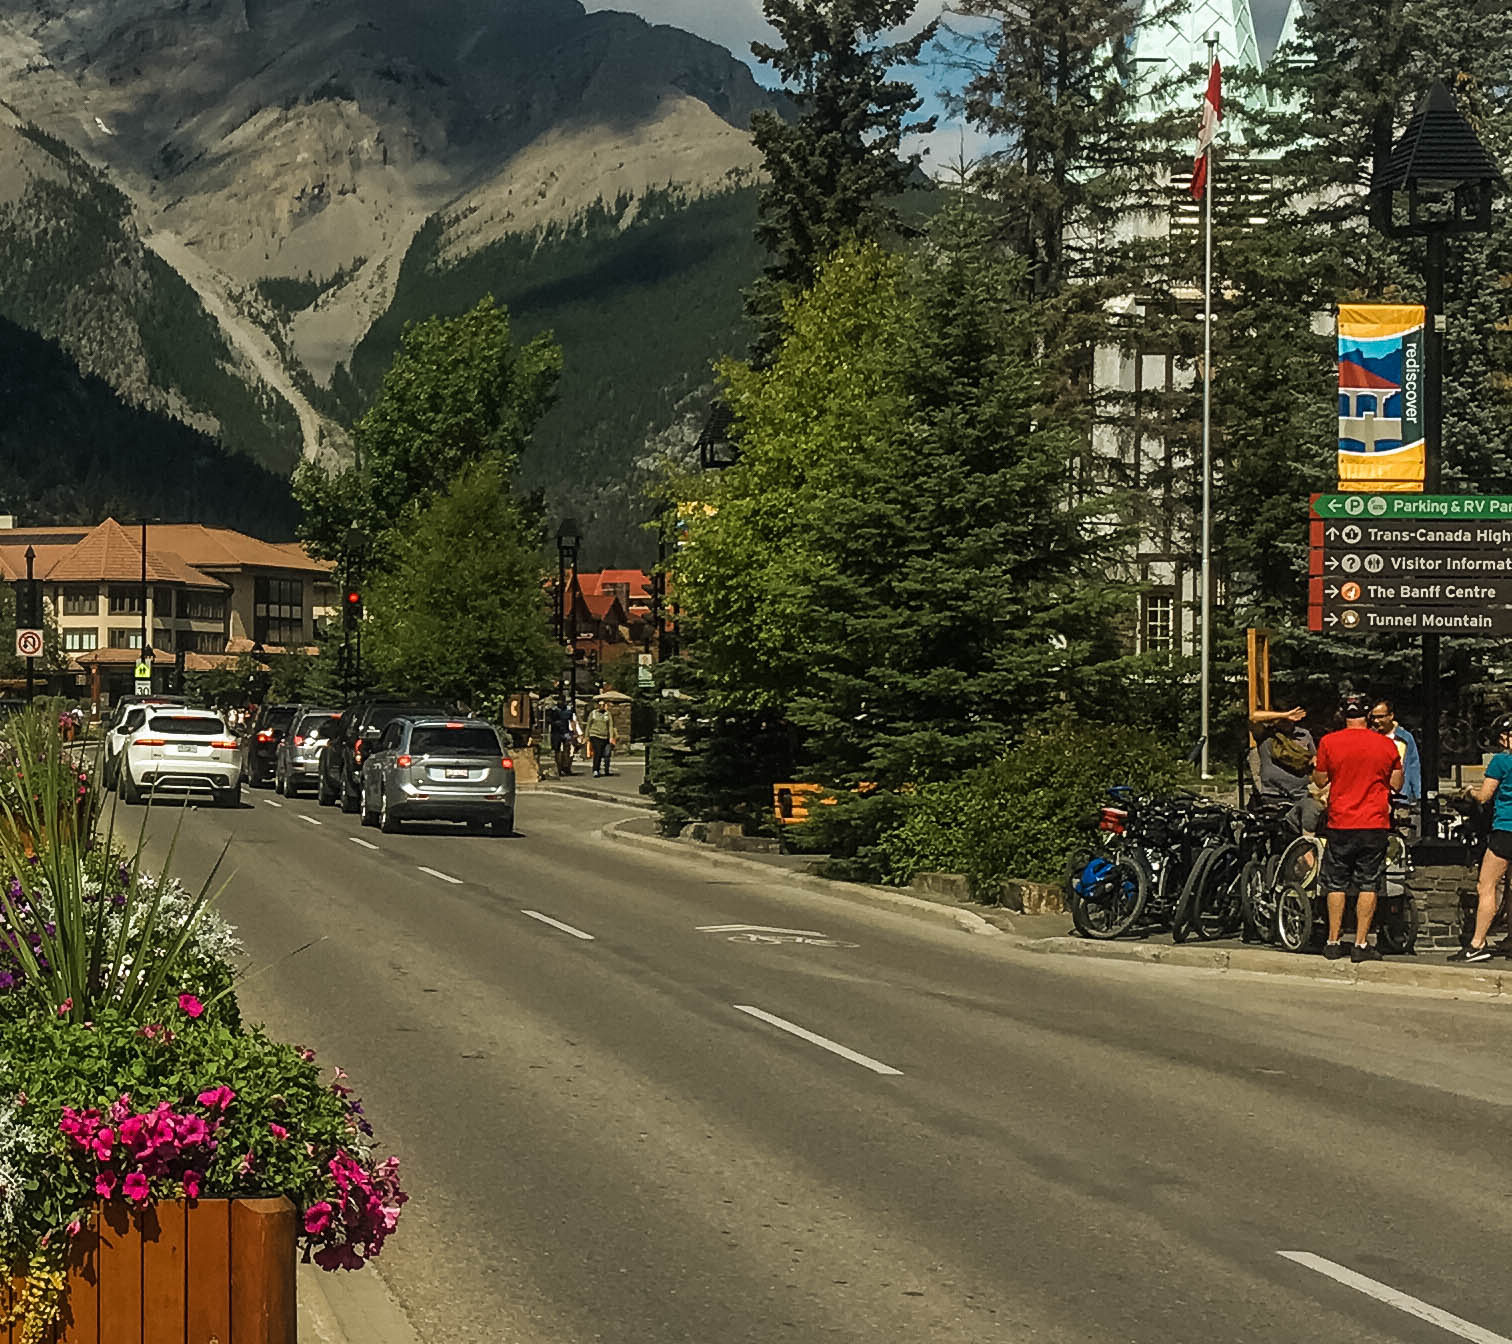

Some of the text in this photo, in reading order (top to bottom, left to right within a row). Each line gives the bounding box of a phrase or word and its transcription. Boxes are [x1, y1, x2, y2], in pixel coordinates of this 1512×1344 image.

[1405, 343, 1420, 424] rediscover
[1393, 499, 1448, 515] Parking
[1450, 500, 1461, 513] &
[1463, 500, 1486, 513] RV
[1367, 528, 1472, 542] Trans-Canada
[1476, 529, 1512, 545] High
[1390, 556, 1443, 570] Visitor
[1367, 585, 1497, 598] The Banff Centre
[1366, 613, 1493, 628] Tunnel Mountain
